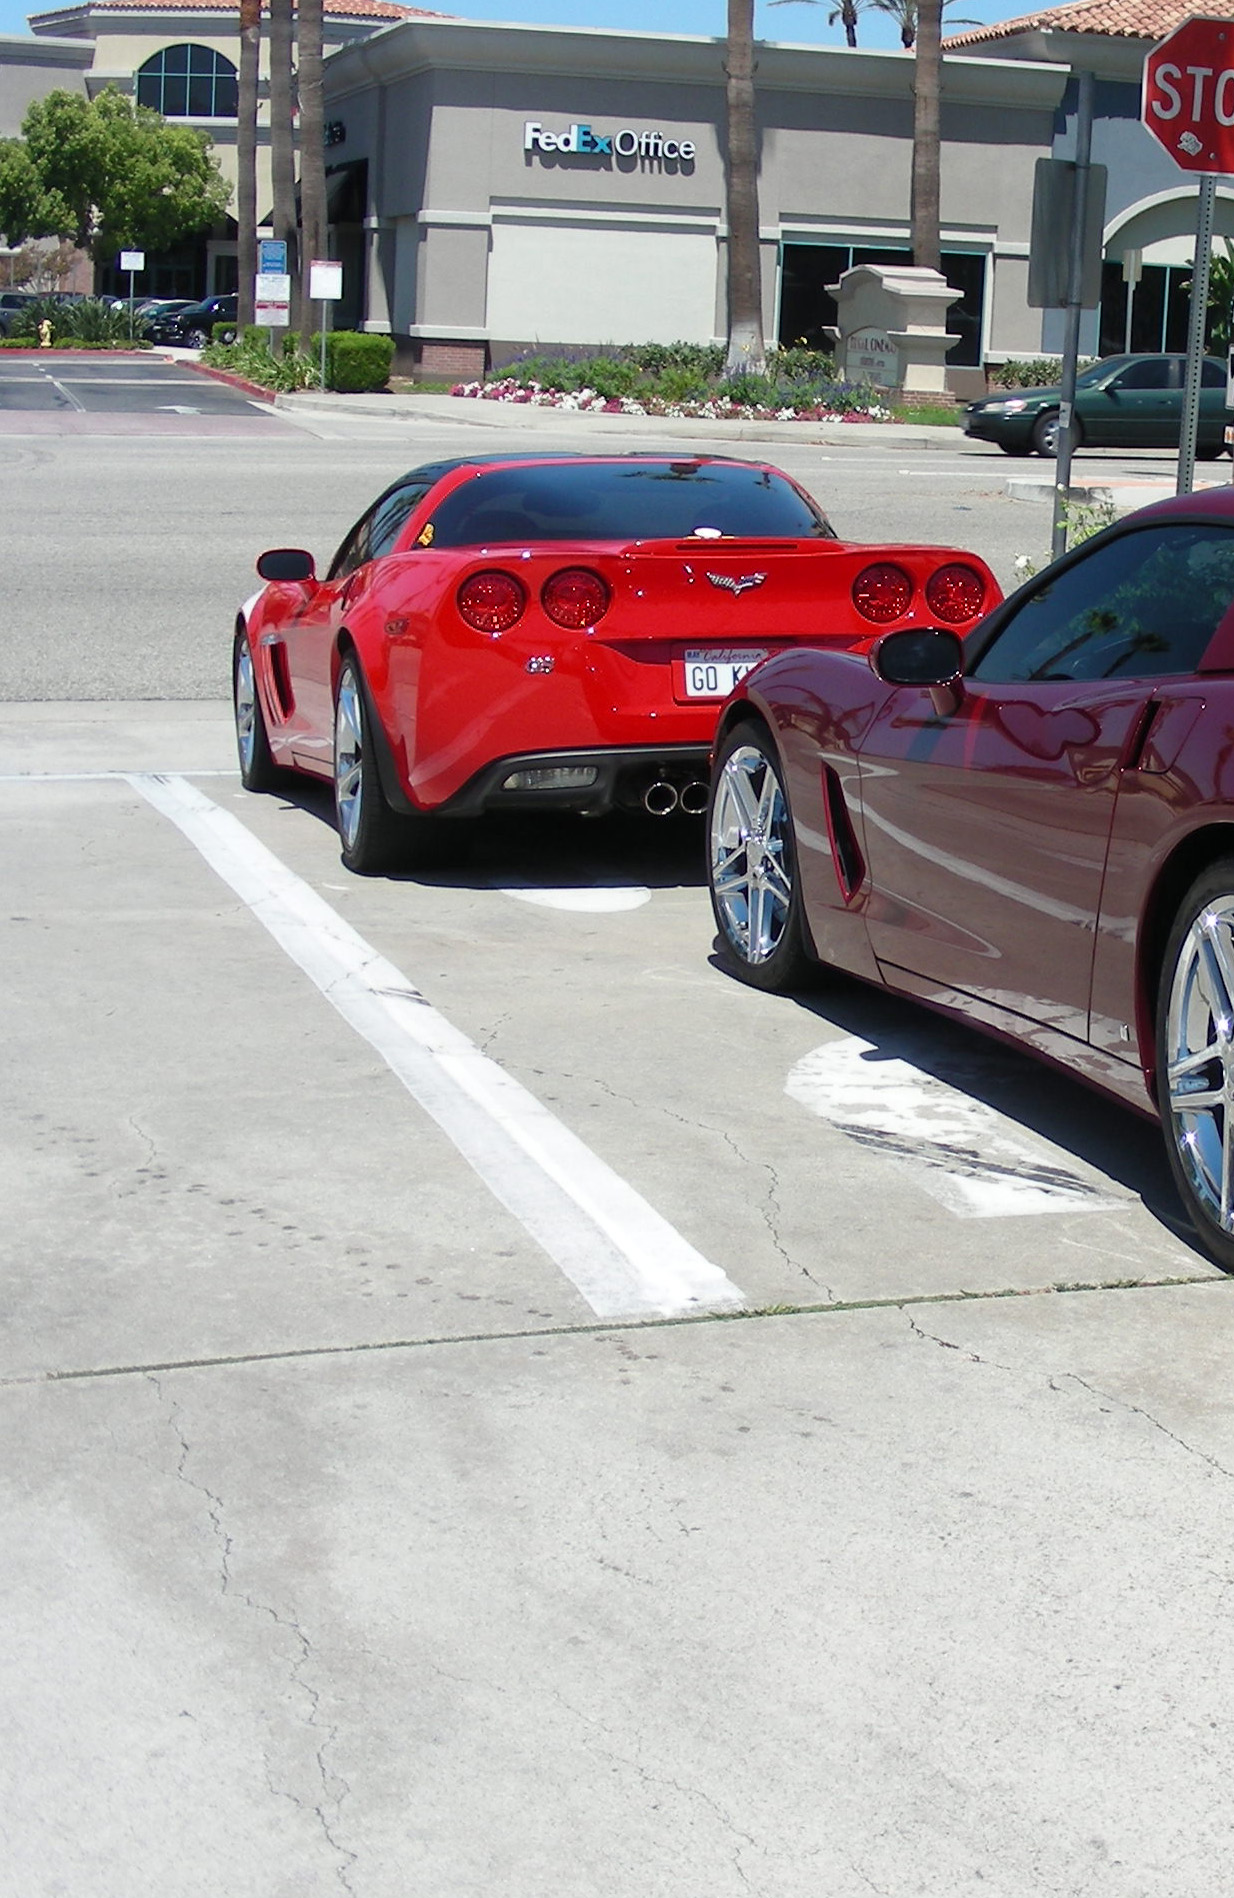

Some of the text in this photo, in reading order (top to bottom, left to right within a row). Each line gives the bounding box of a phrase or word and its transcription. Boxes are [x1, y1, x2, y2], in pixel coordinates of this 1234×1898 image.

[524, 121, 696, 159] FedEx Office
[703, 649, 762, 664] California
[692, 666, 718, 691] GO
